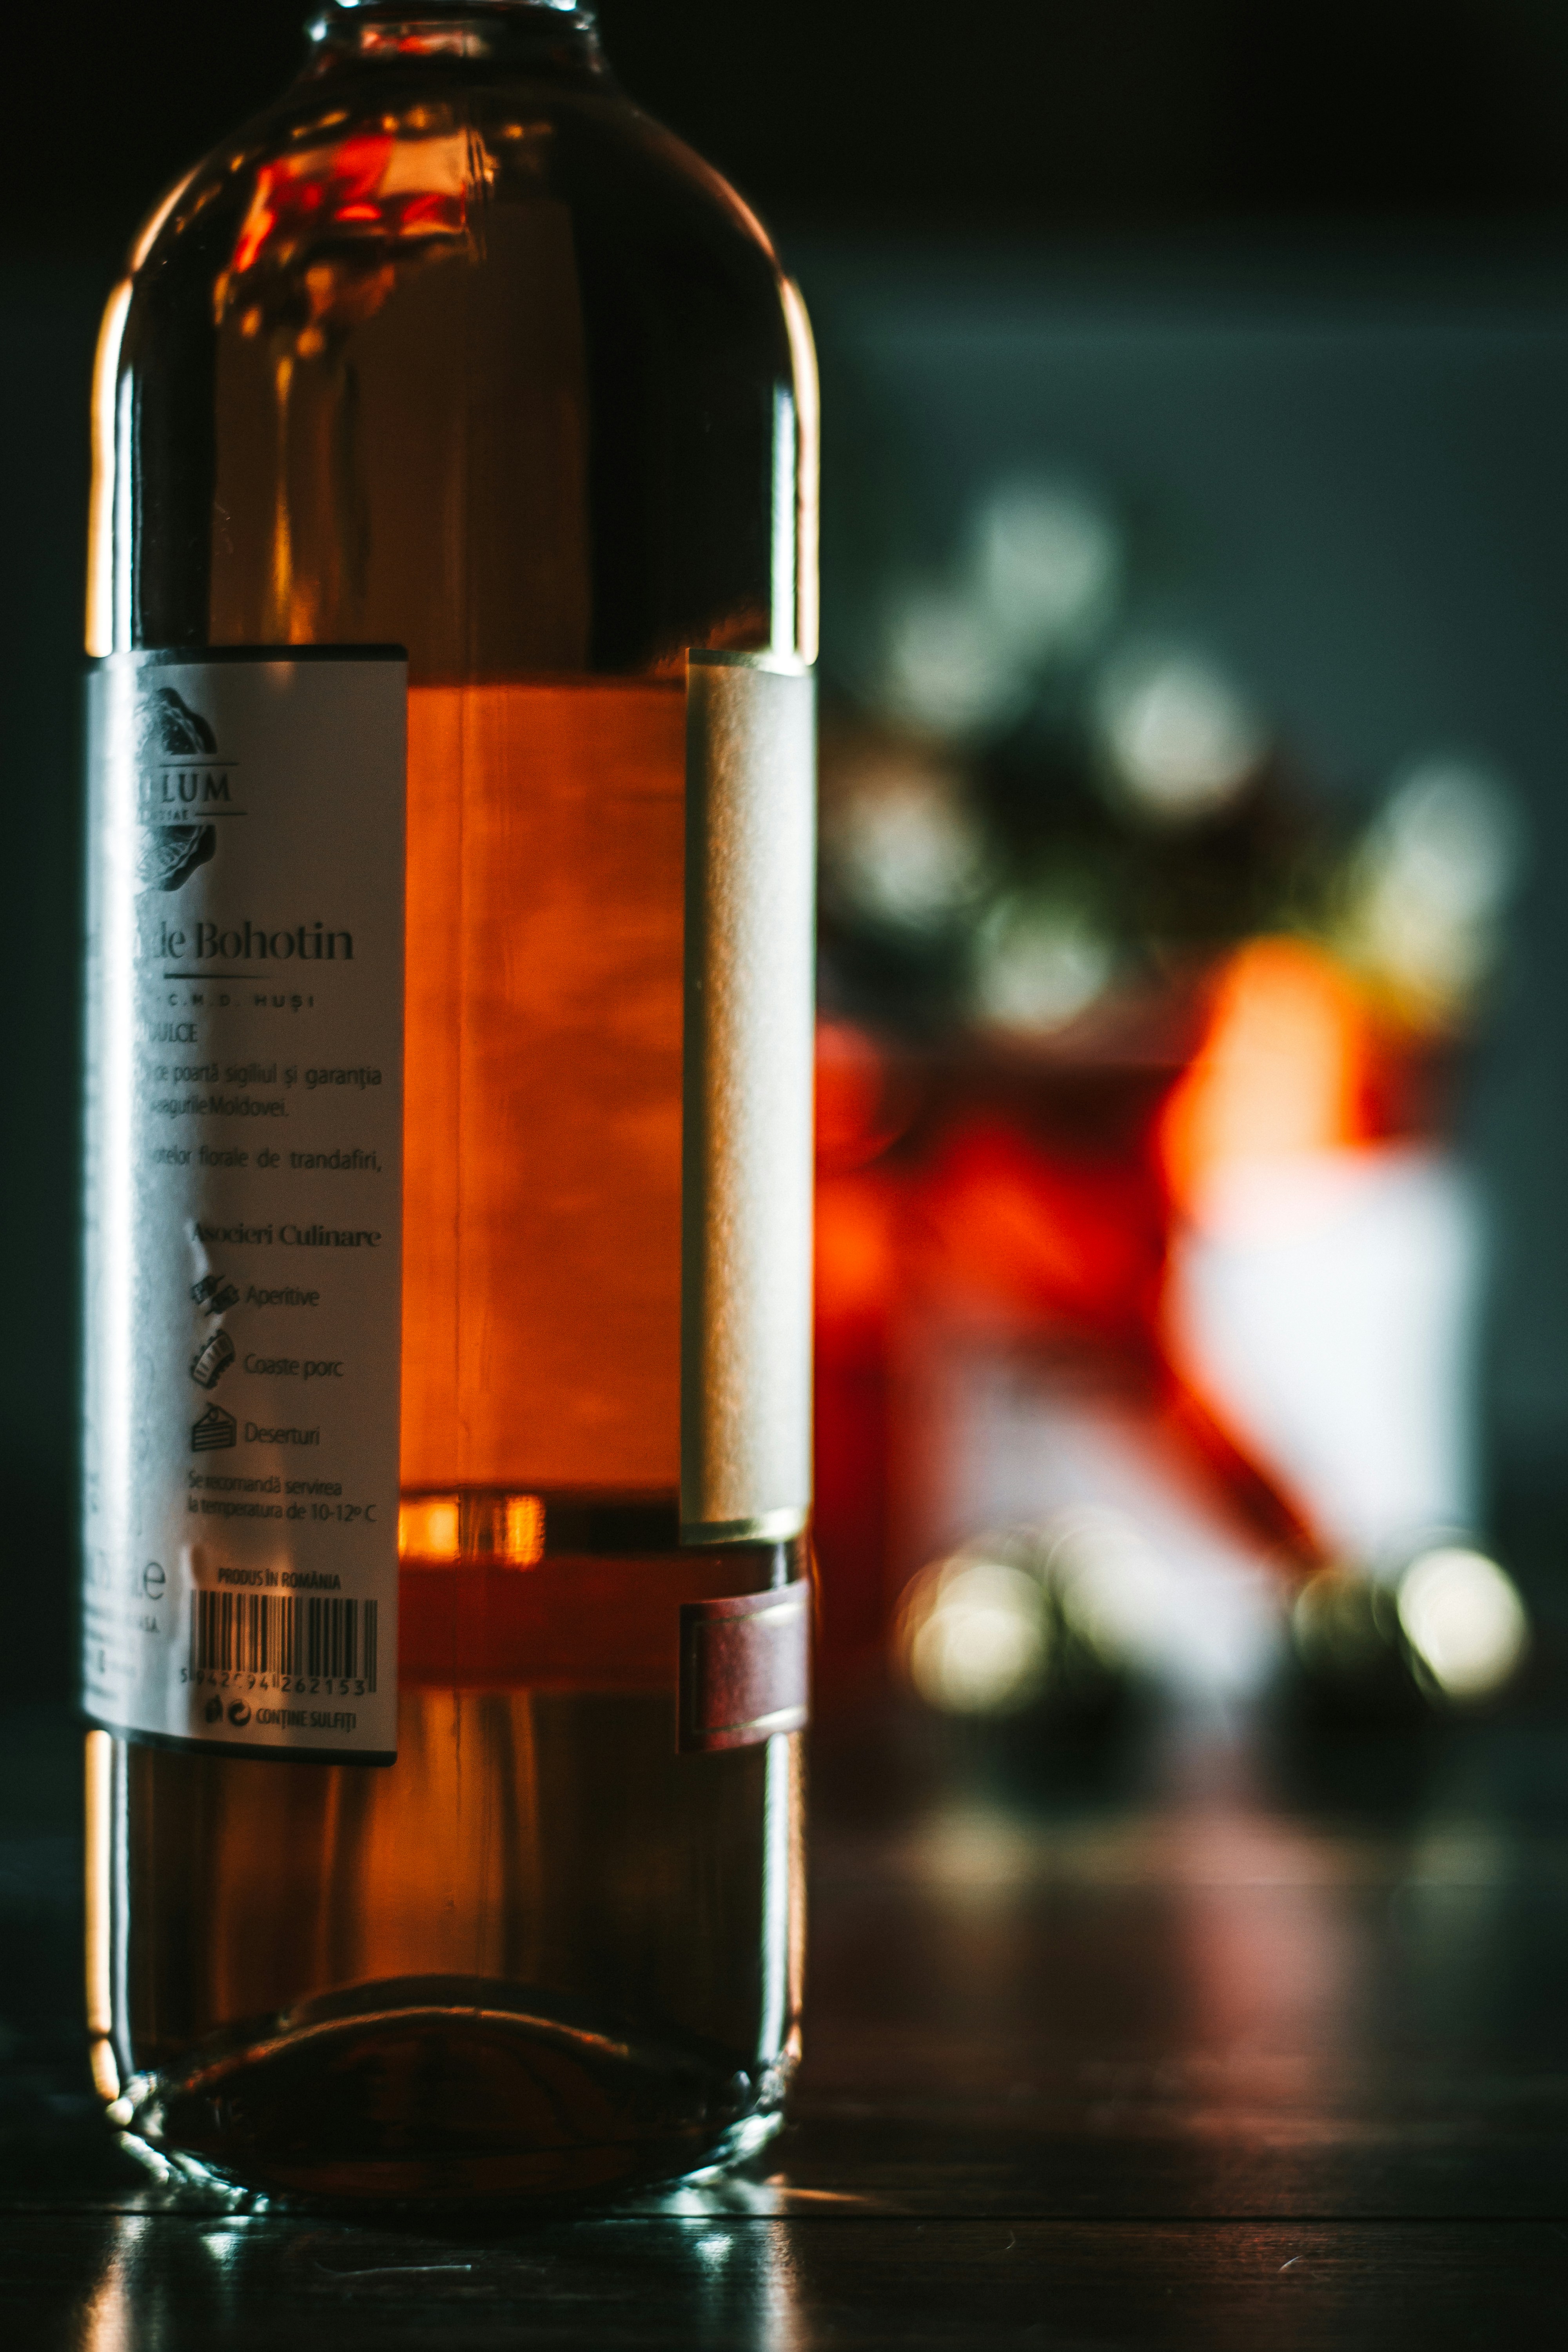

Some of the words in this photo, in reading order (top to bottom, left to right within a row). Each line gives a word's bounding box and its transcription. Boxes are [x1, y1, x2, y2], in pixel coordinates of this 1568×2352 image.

[151, 773, 232, 802] LUM
[196, 921, 354, 960] Bohotin
[257, 1147, 281, 1169] de
[289, 1147, 382, 1173] trandafiri,
[279, 1224, 382, 1247] Culinare
[245, 1285, 321, 1309] Aperitive
[243, 1353, 300, 1376] Coaste
[303, 1359, 345, 1381] porc
[244, 1421, 321, 1446] Deserturi
[285, 1478, 343, 1496] servirea
[286, 1502, 307, 1520] de
[218, 1568, 263, 1586] PRODUS
[281, 1570, 341, 1590] ROMÂNIA
